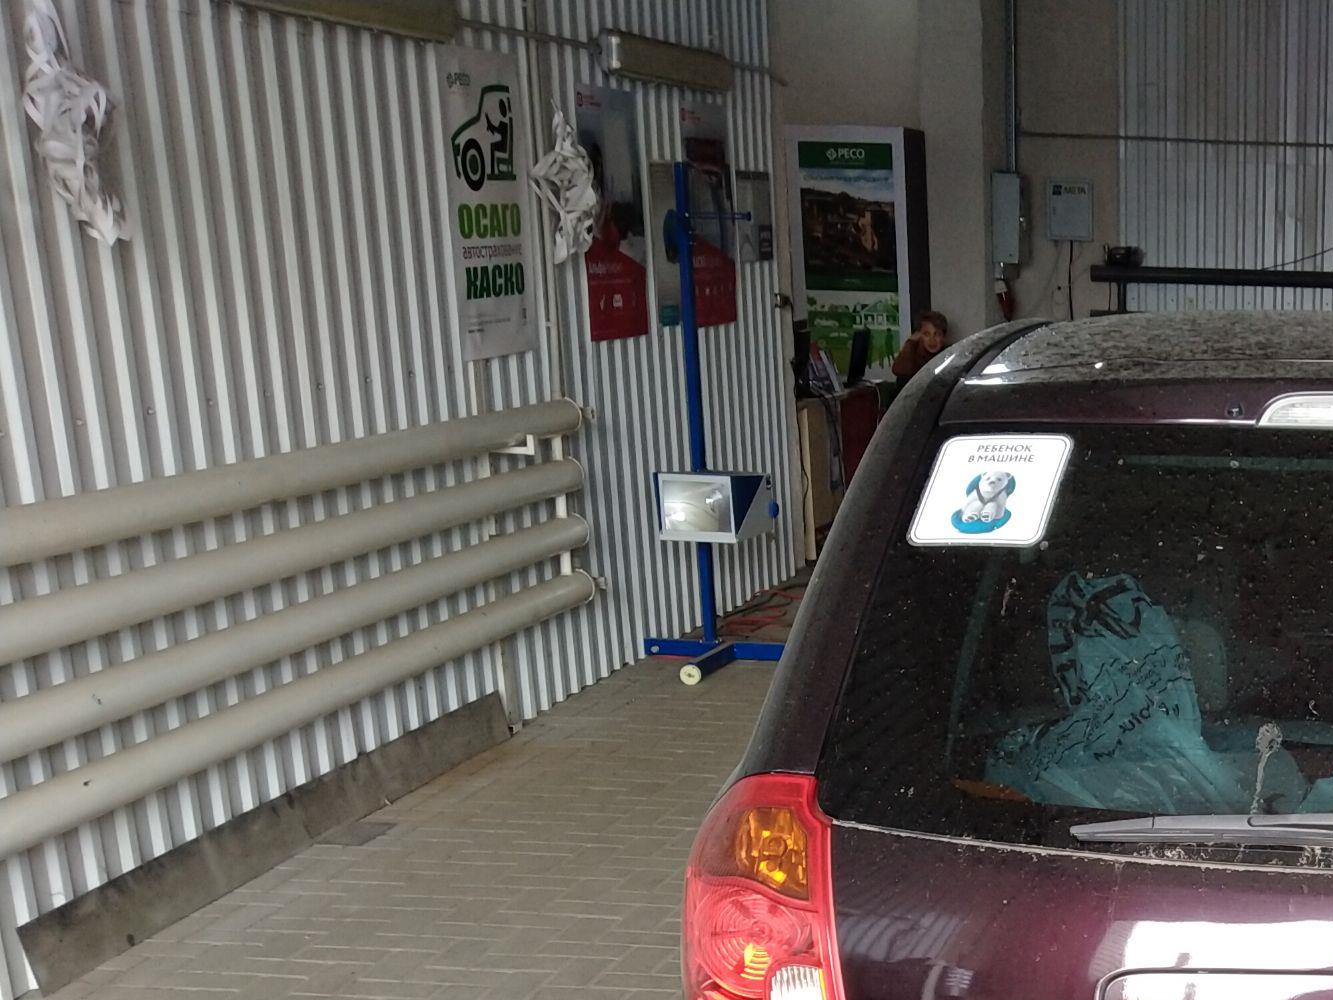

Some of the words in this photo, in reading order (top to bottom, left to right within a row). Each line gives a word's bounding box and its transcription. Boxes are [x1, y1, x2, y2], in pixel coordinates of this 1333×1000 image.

[837, 147, 865, 159] РЕСО
[457, 203, 522, 239] ОСАГО
[465, 262, 525, 300] КАСКО
[976, 444, 1033, 453] РЕБЕНОК
[976, 454, 1035, 463] МАШИНЕ
